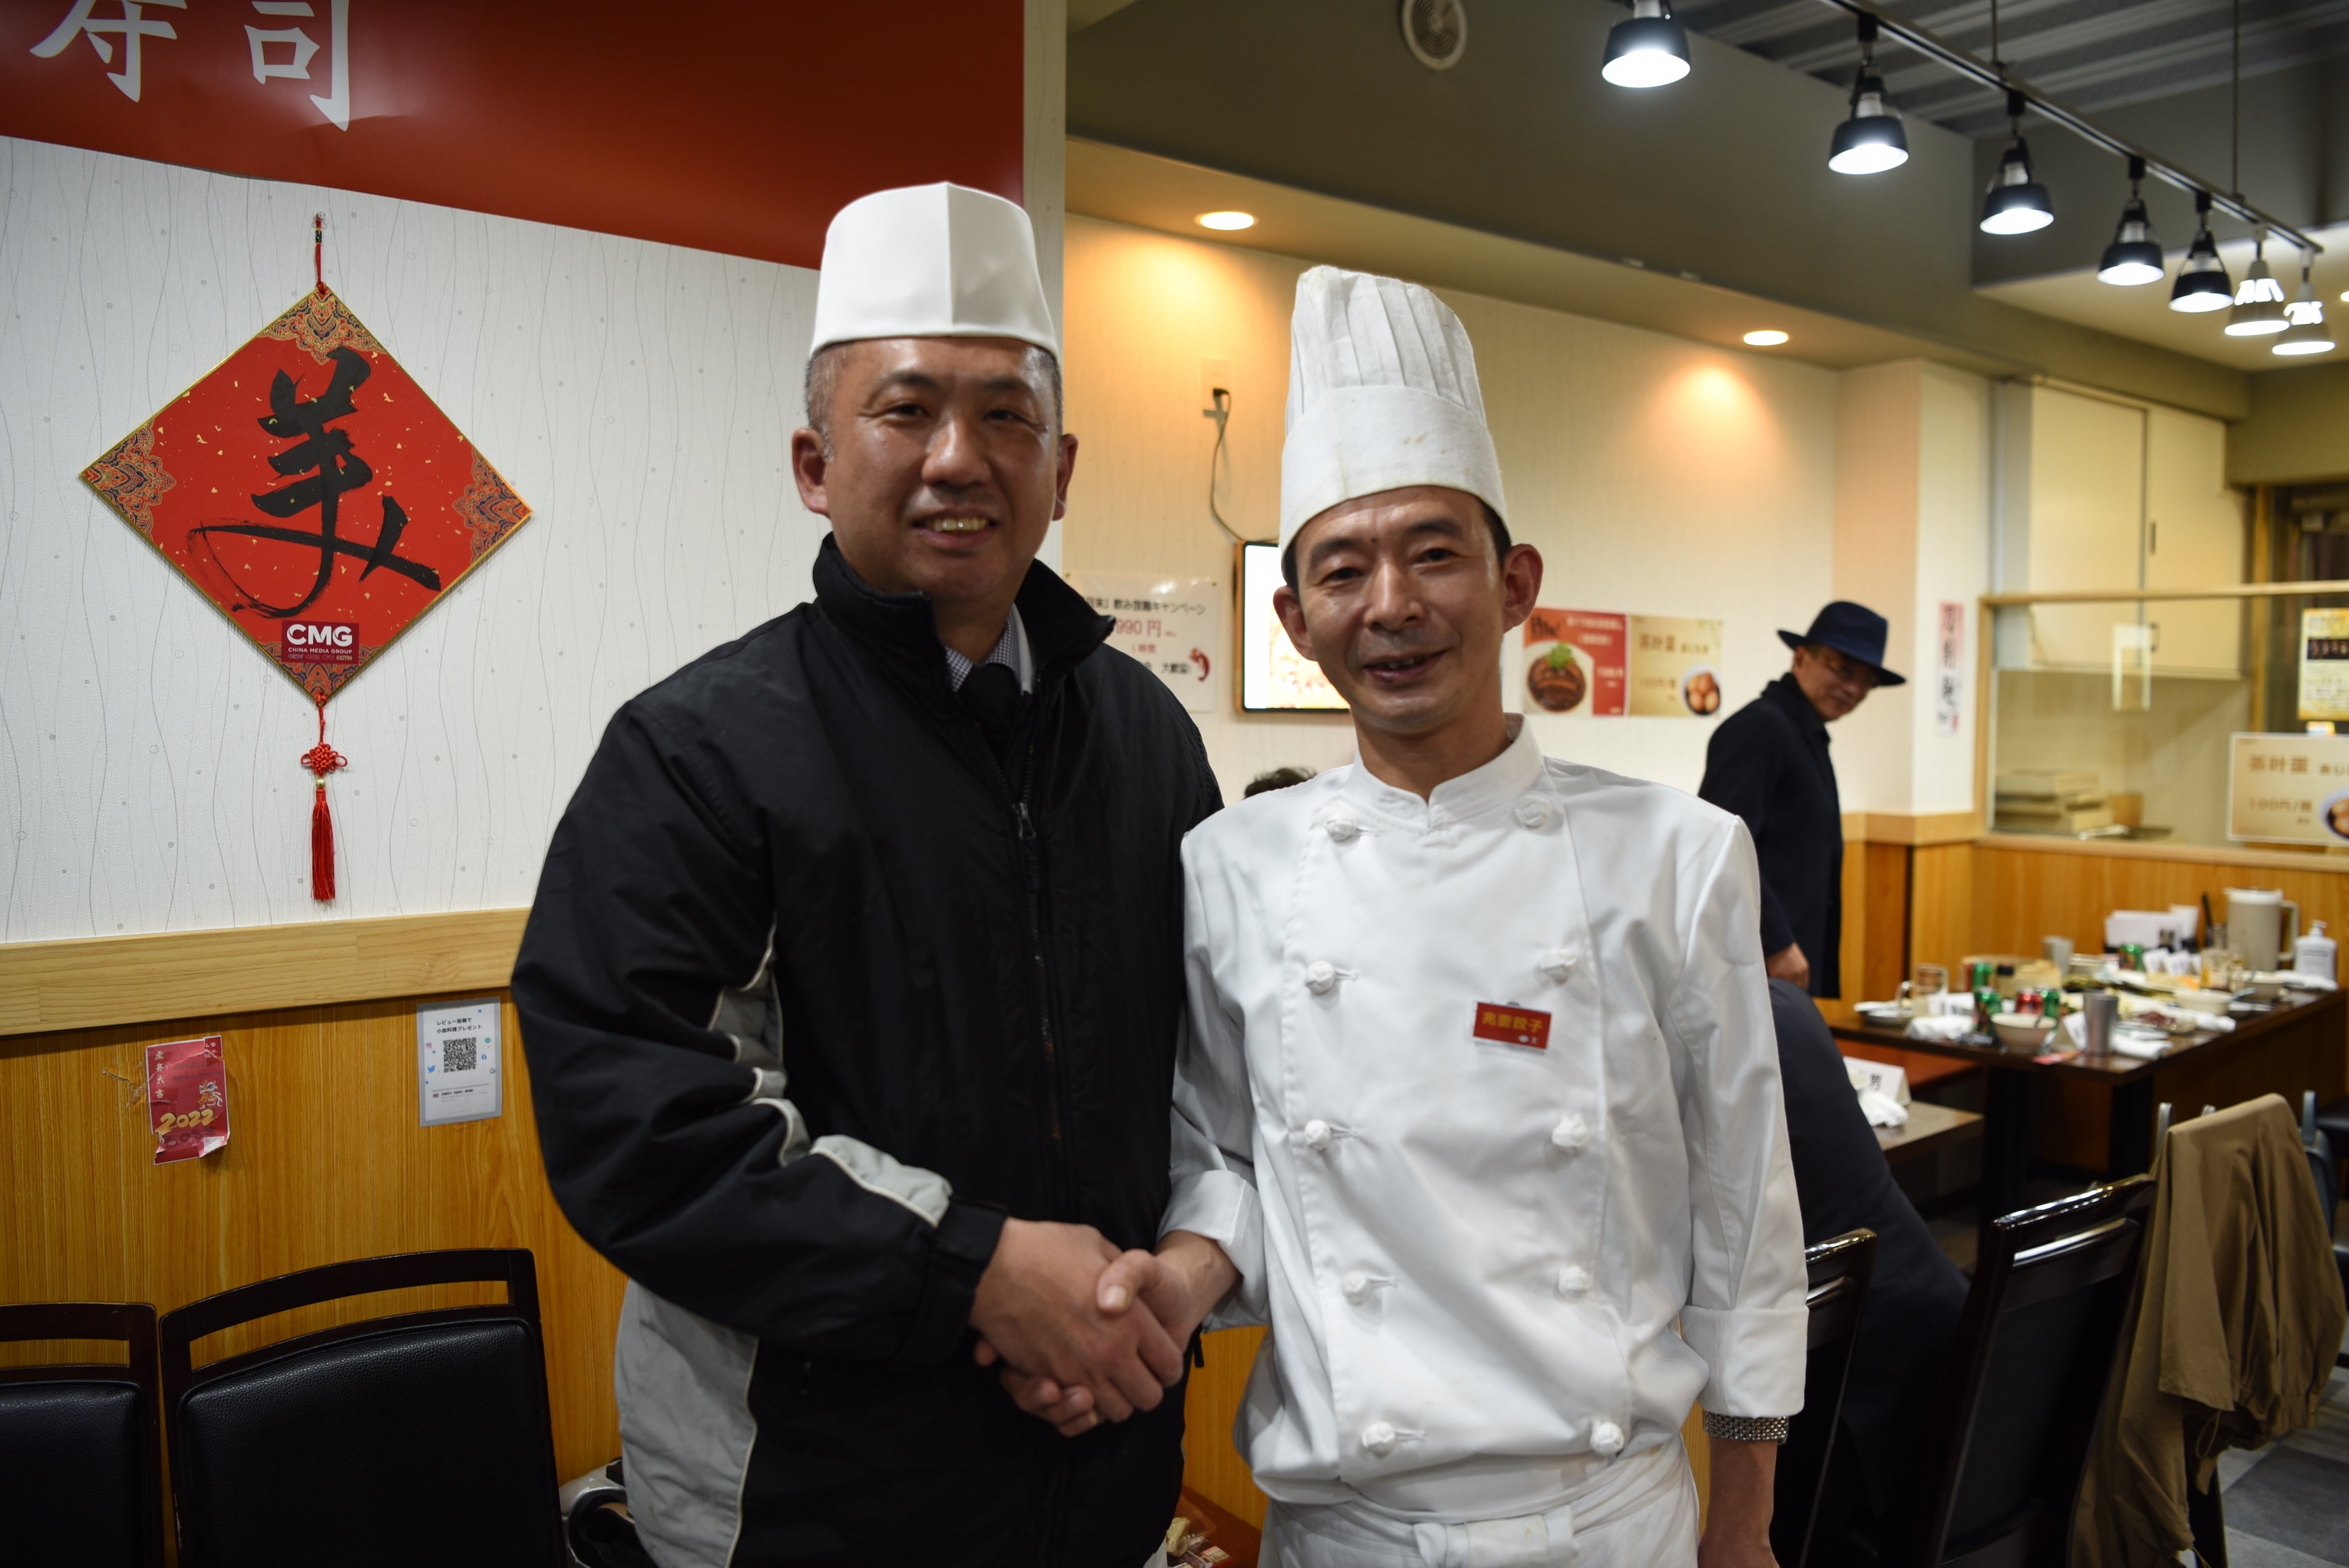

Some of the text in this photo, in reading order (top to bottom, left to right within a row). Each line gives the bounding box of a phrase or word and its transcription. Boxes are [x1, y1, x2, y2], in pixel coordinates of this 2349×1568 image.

[29, 0, 350, 132] 寿司
[287, 624, 353, 647] CMG
[437, 1017, 472, 1026] レビュー投稿で
[155, 1109, 216, 1135] 2022
